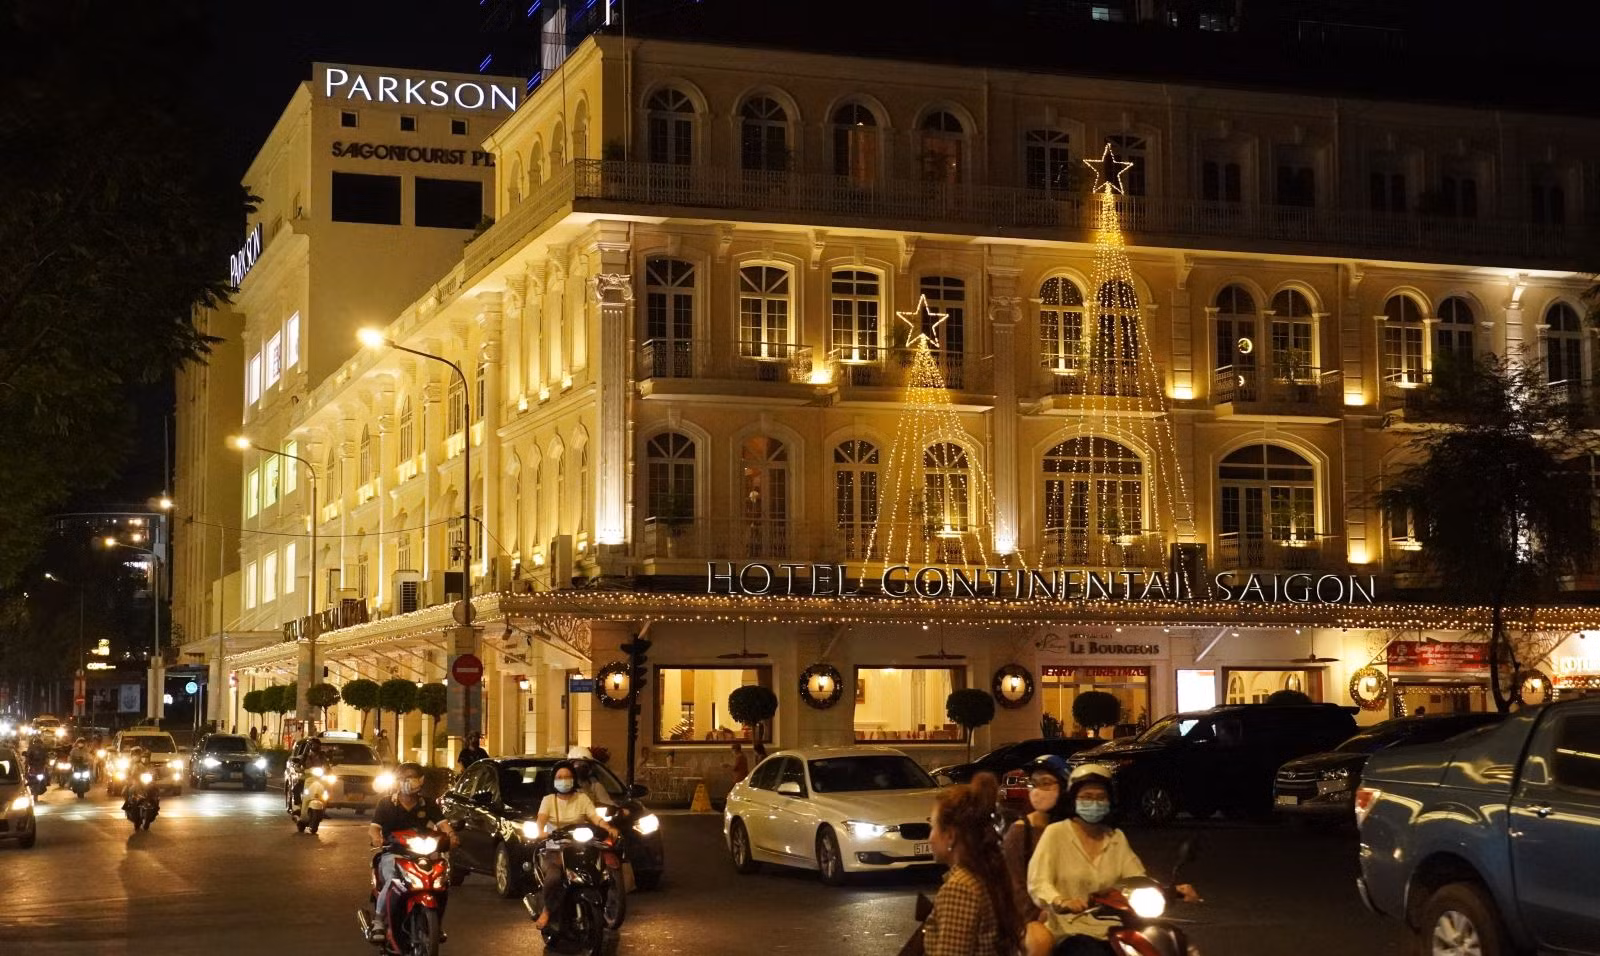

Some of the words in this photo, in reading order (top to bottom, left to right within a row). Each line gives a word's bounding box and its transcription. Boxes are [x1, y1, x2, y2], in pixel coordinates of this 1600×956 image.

[325, 67, 517, 113] PARKSON
[331, 141, 468, 166] SAIGONTOURIST
[471, 150, 496, 168] PL
[230, 223, 260, 288] PARKSON
[706, 561, 860, 597] HOTEL
[881, 565, 1194, 600] CONTINENTAL
[1213, 570, 1376, 605] SAIGON
